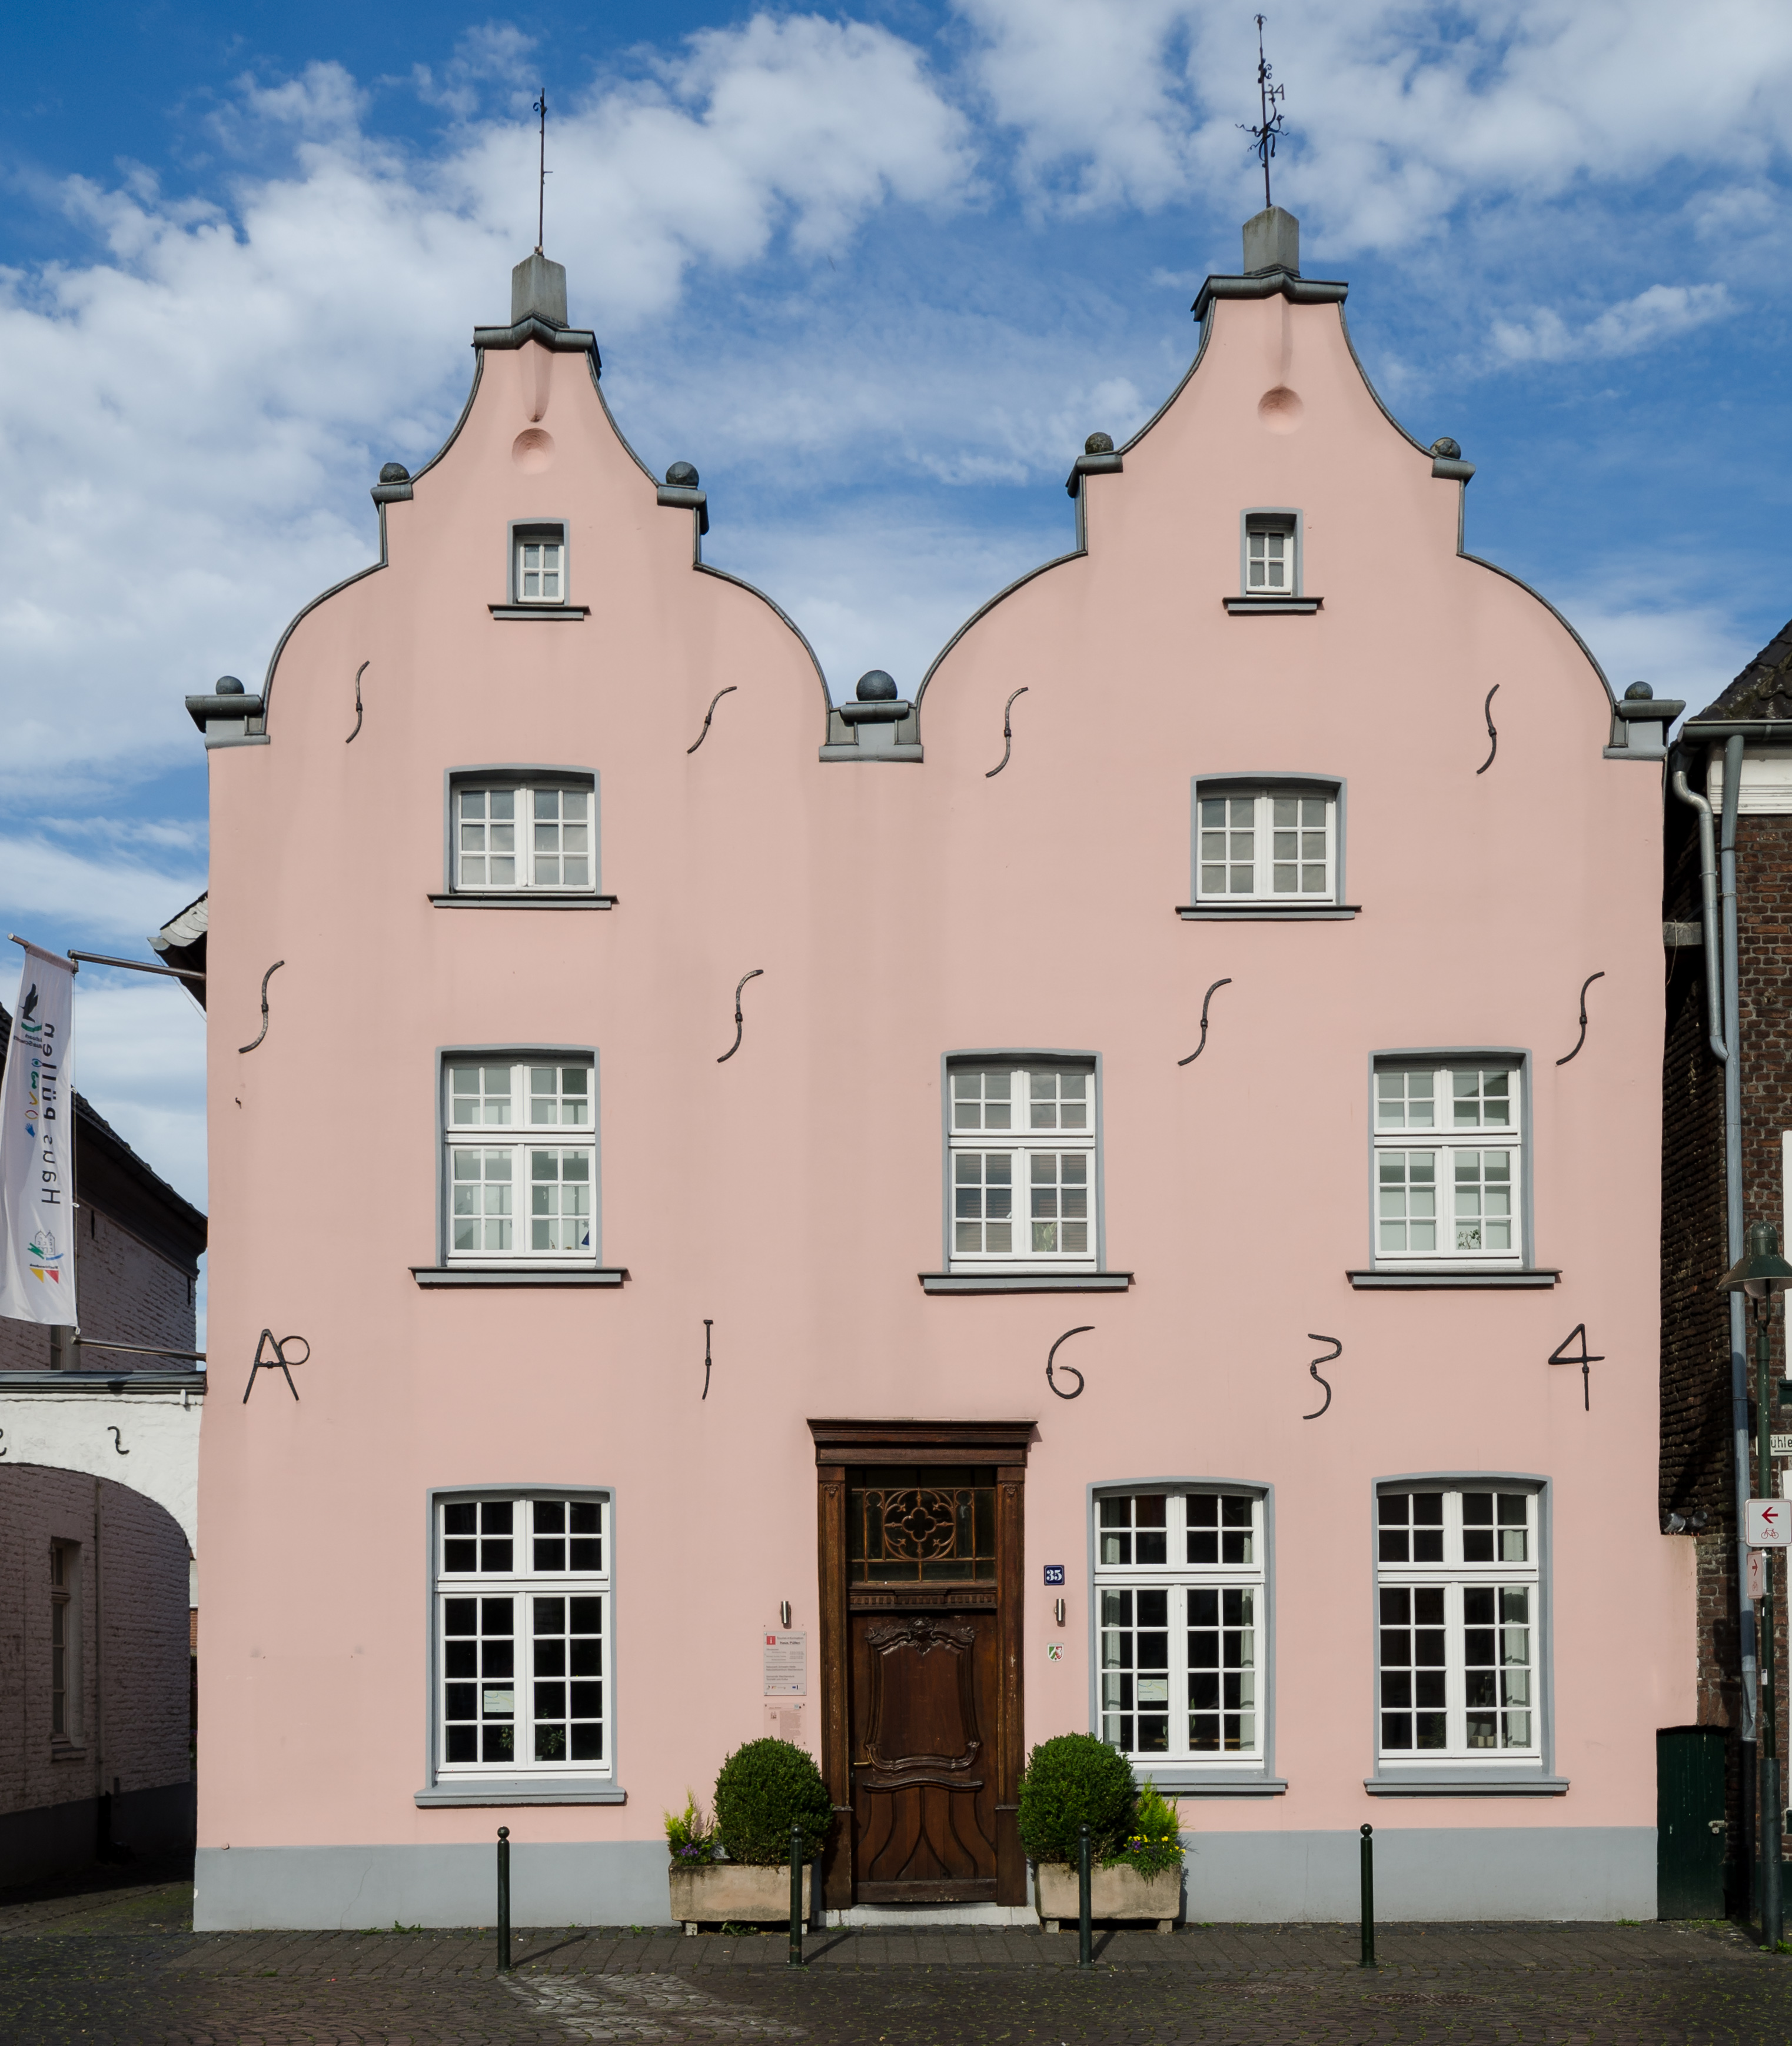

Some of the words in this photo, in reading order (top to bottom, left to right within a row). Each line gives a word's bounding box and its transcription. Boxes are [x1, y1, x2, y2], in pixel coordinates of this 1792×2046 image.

[1046, 1325, 1095, 1399] 6
[1303, 1333, 1342, 1420] 3
[1547, 1323, 1605, 1411] 4
[1771, 1436, 1792, 1448] ühle
[1046, 1569, 1062, 1581] 35
